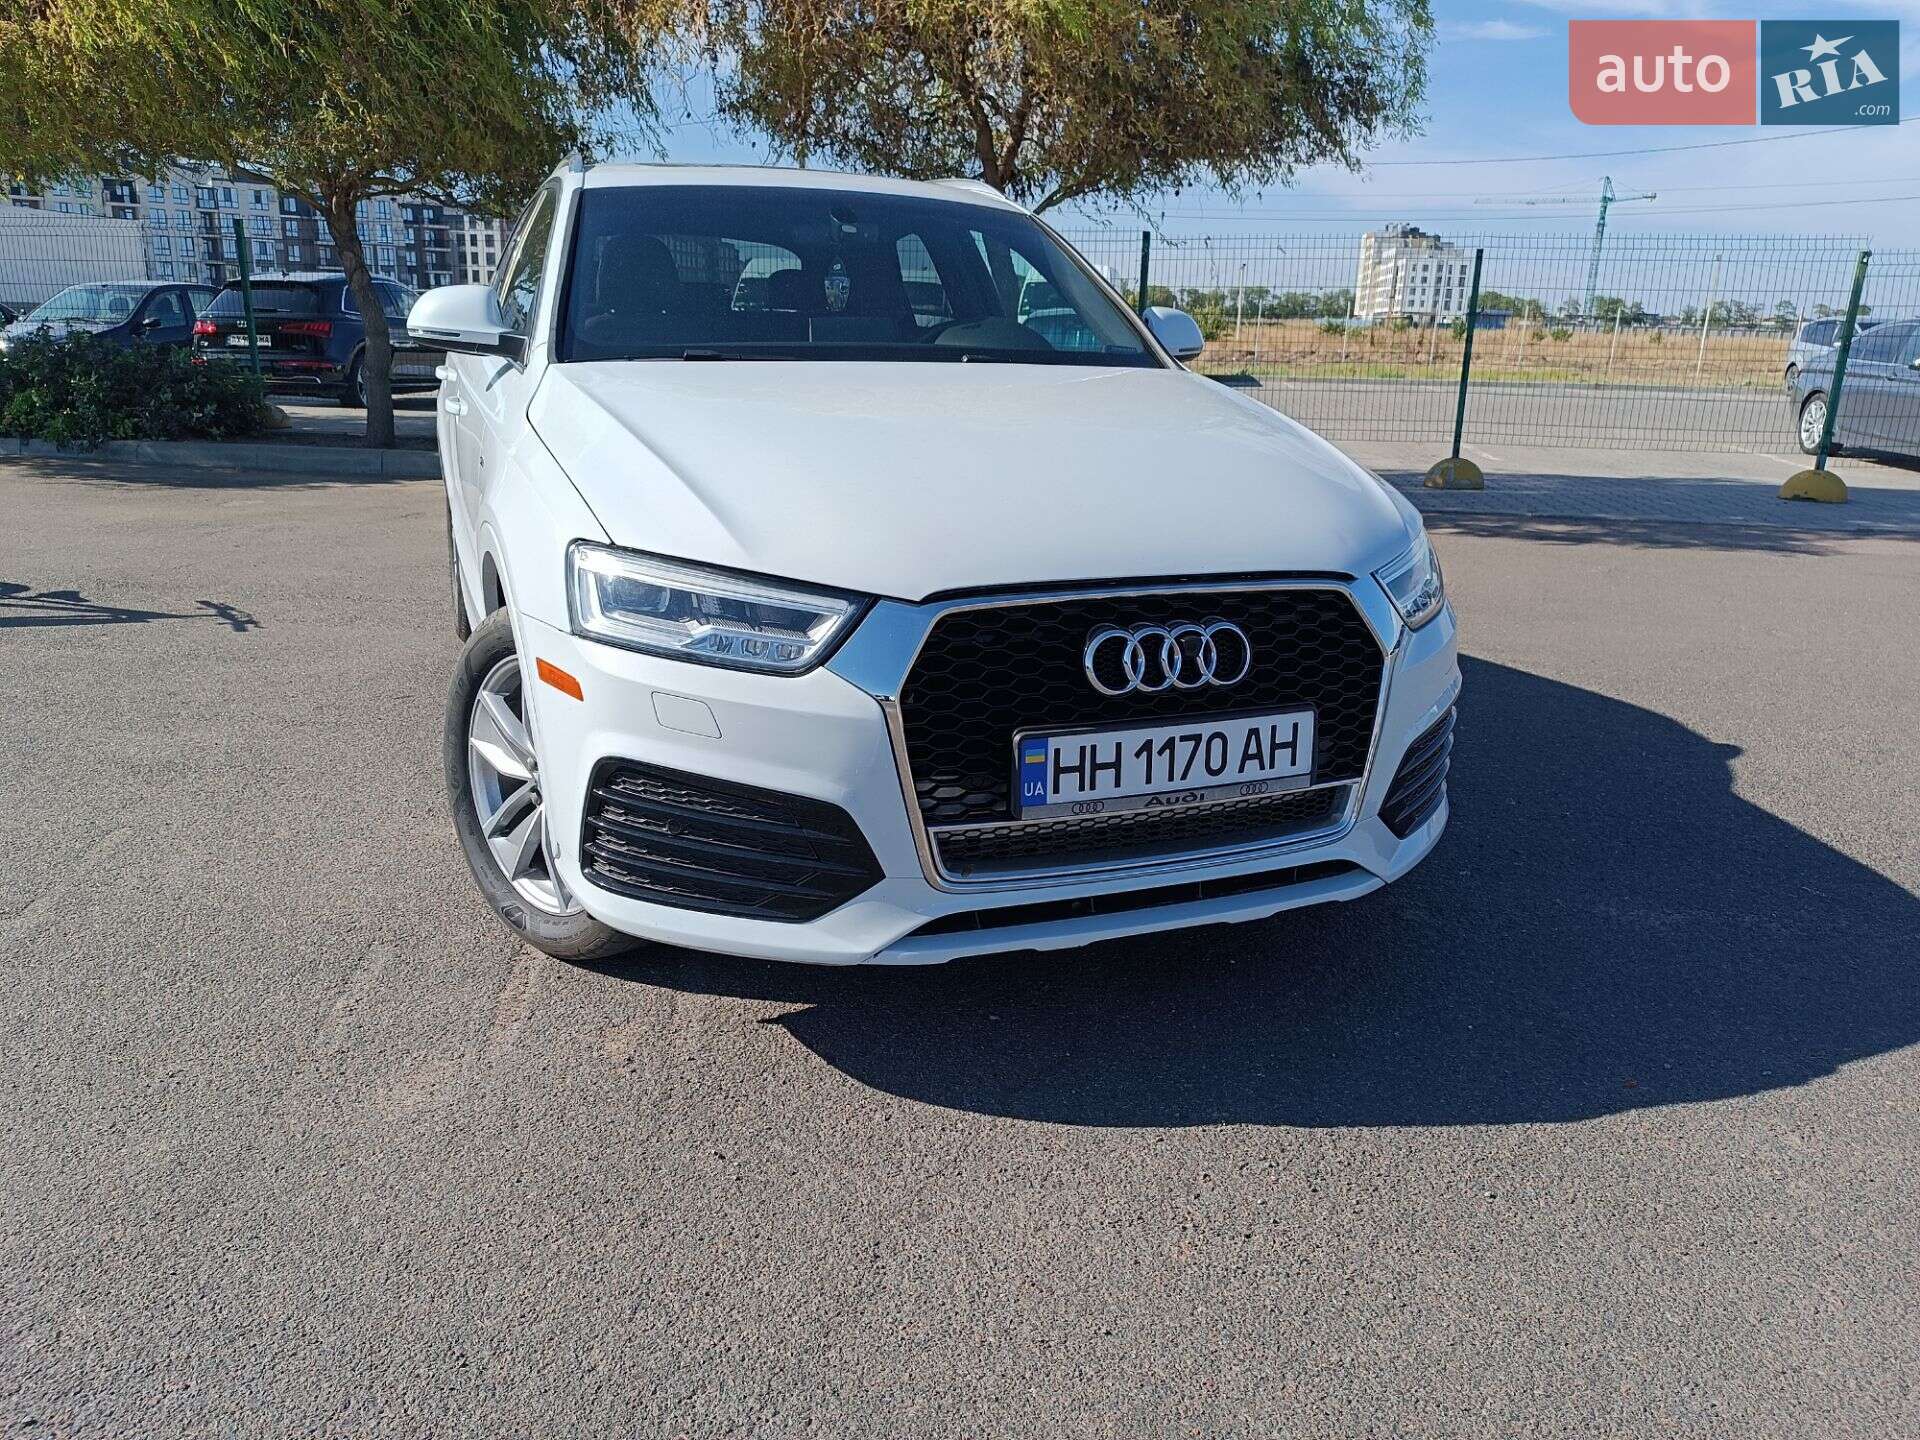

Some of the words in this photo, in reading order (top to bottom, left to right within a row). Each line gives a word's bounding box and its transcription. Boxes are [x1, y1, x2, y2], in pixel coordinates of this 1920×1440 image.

[1052, 741, 1122, 795] HH
[1134, 731, 1228, 785] 1170
[1237, 722, 1299, 774] AH
[1024, 781, 1045, 796] UA
